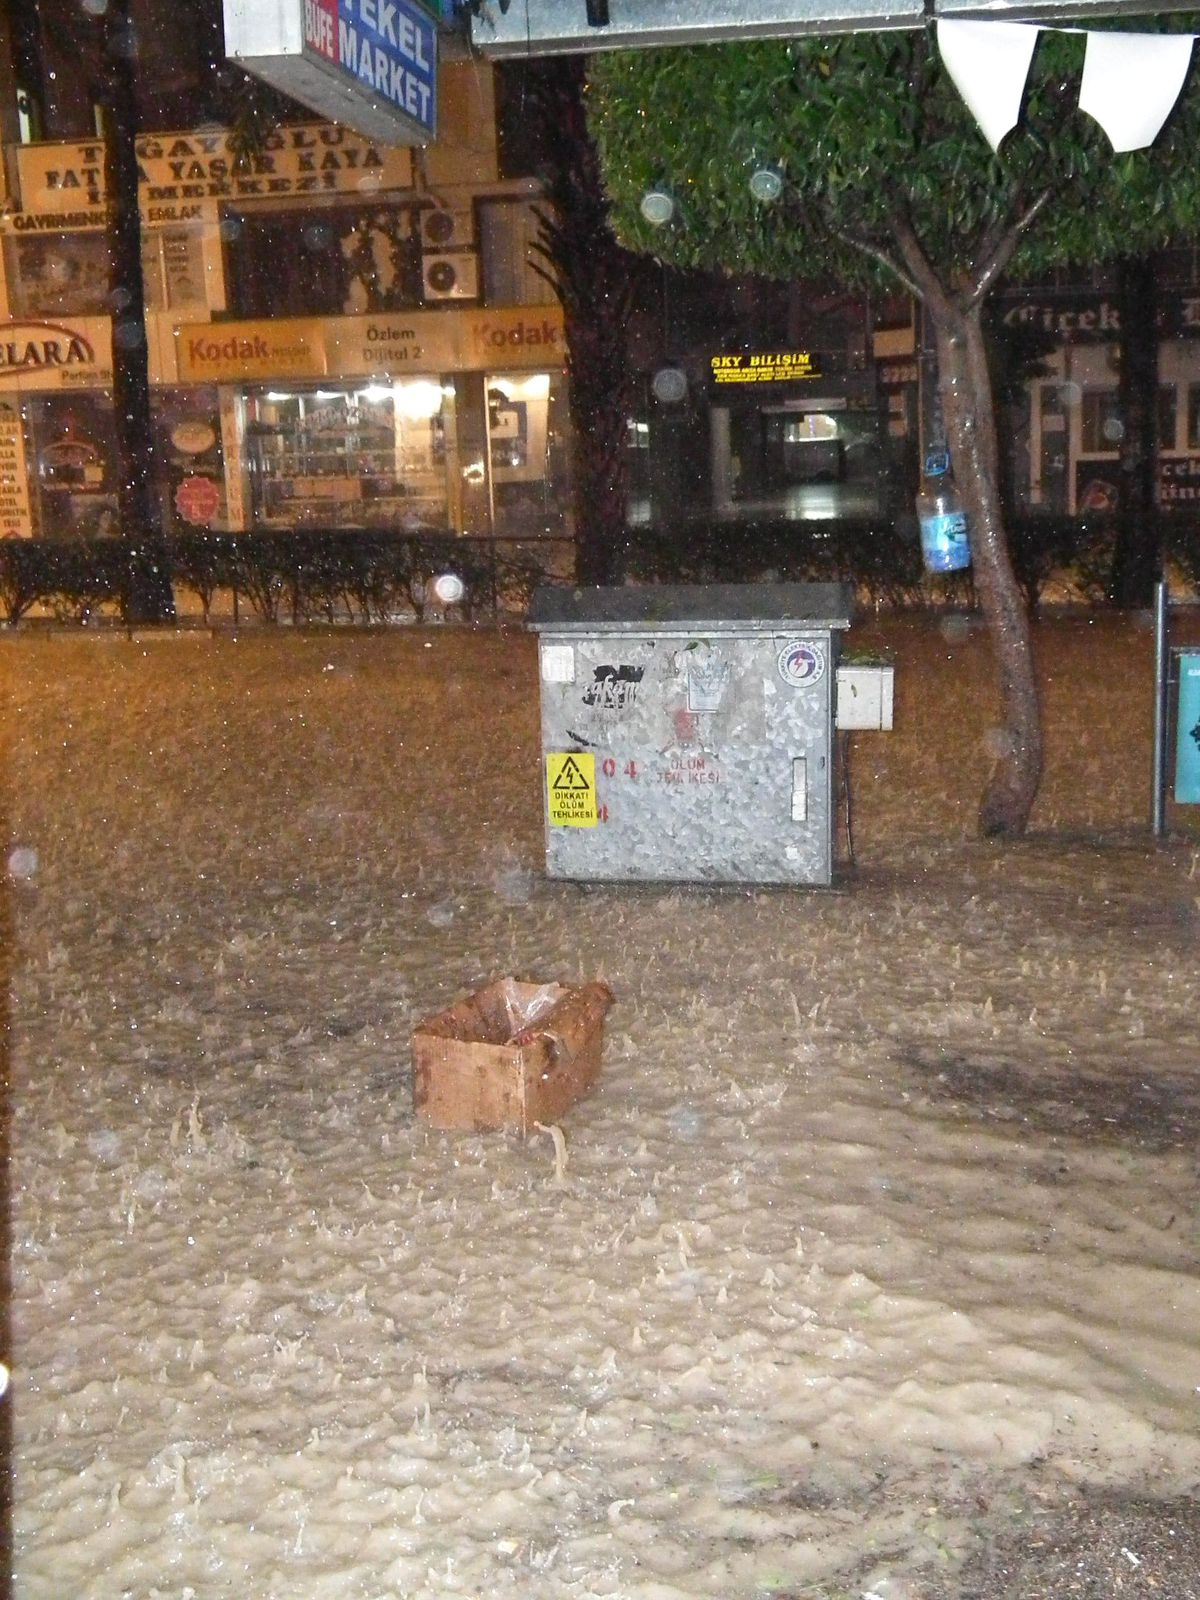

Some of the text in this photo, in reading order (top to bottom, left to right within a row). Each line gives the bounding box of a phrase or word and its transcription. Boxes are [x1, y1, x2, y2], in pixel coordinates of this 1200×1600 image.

[339, 18, 431, 122] MARKET
[297, 148, 383, 174] KAYA
[366, 324, 416, 342] Özlem
[473, 320, 557, 348] Kodak
[188, 334, 269, 362] Kodak
[412, 346, 422, 360] 2
[710, 353, 811, 368] SKY BİLİŞİM
[560, 800, 584, 809] ÖLÜM
[553, 809, 593, 819] TEHLİKESİ
